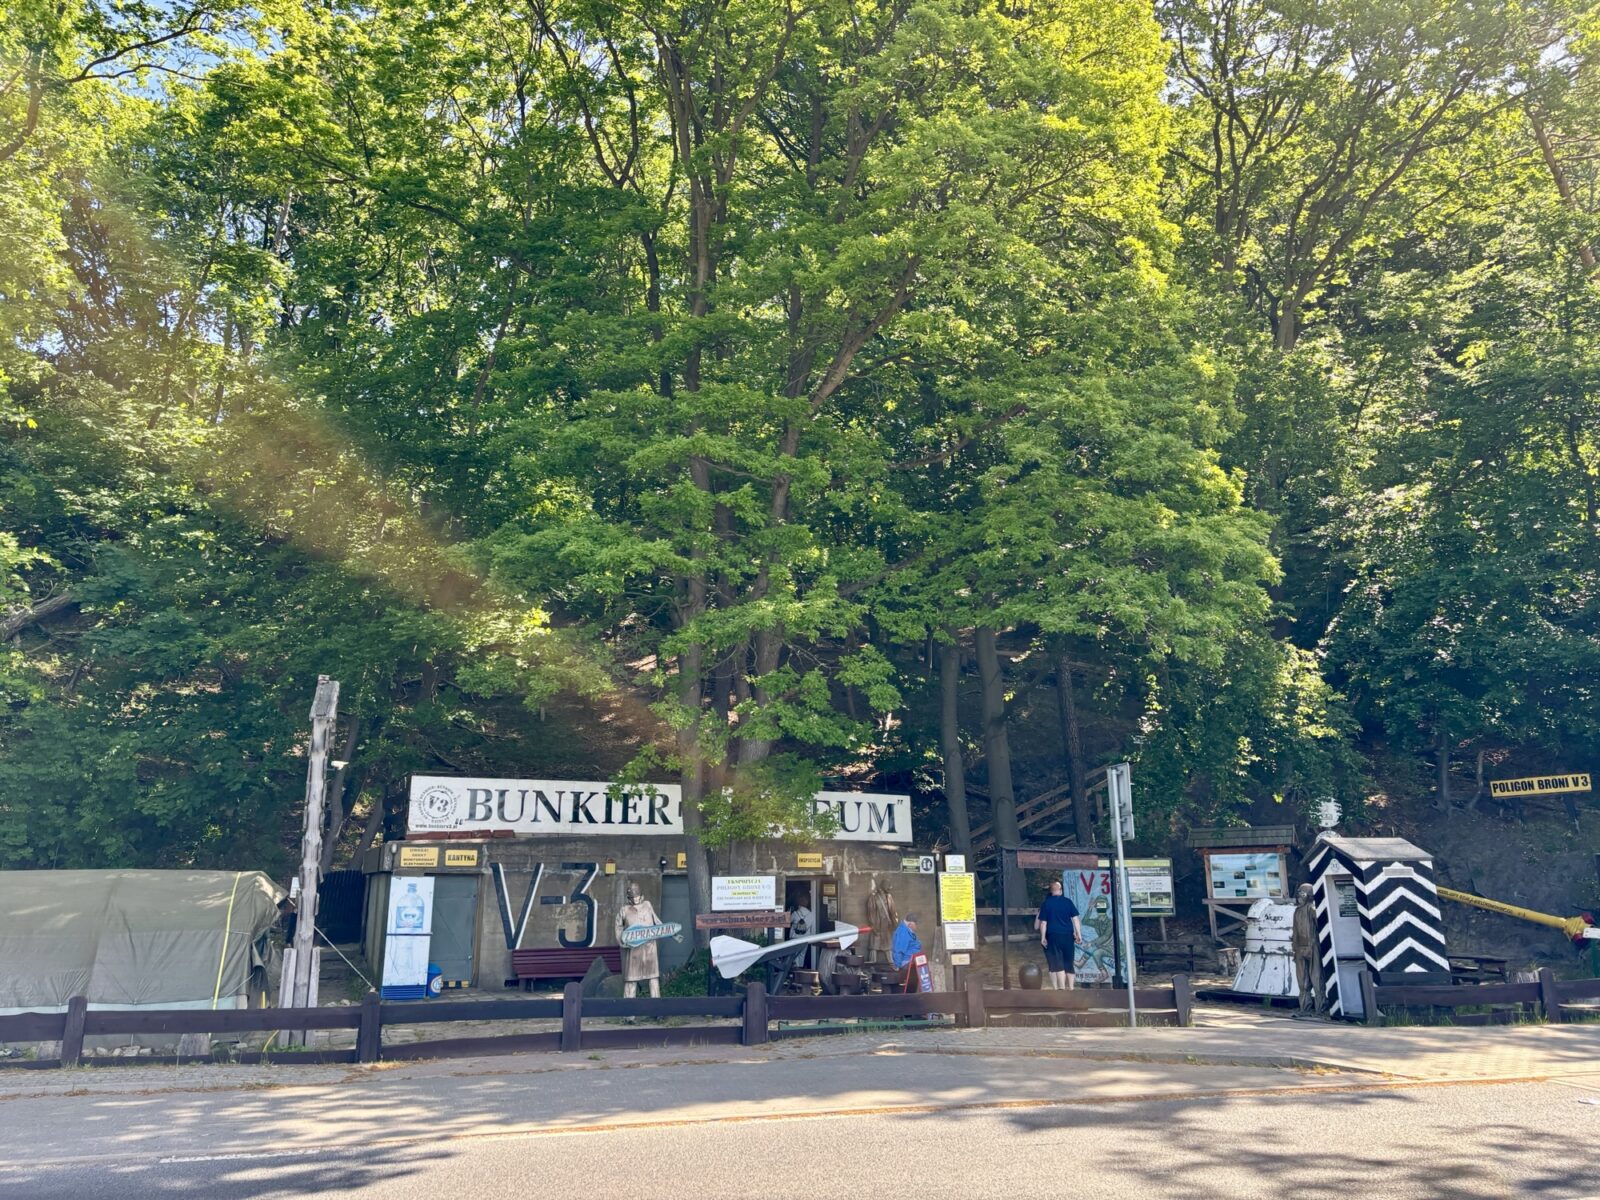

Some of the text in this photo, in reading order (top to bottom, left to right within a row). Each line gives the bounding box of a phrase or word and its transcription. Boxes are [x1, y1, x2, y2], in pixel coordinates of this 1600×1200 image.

[1492, 780, 1535, 794] POLIGON
[1537, 777, 1570, 790] BRONI
[447, 854, 475, 862] KANTYNA
[489, 862, 599, 950] V-3
[625, 924, 676, 941] ZAPRASZAMY
